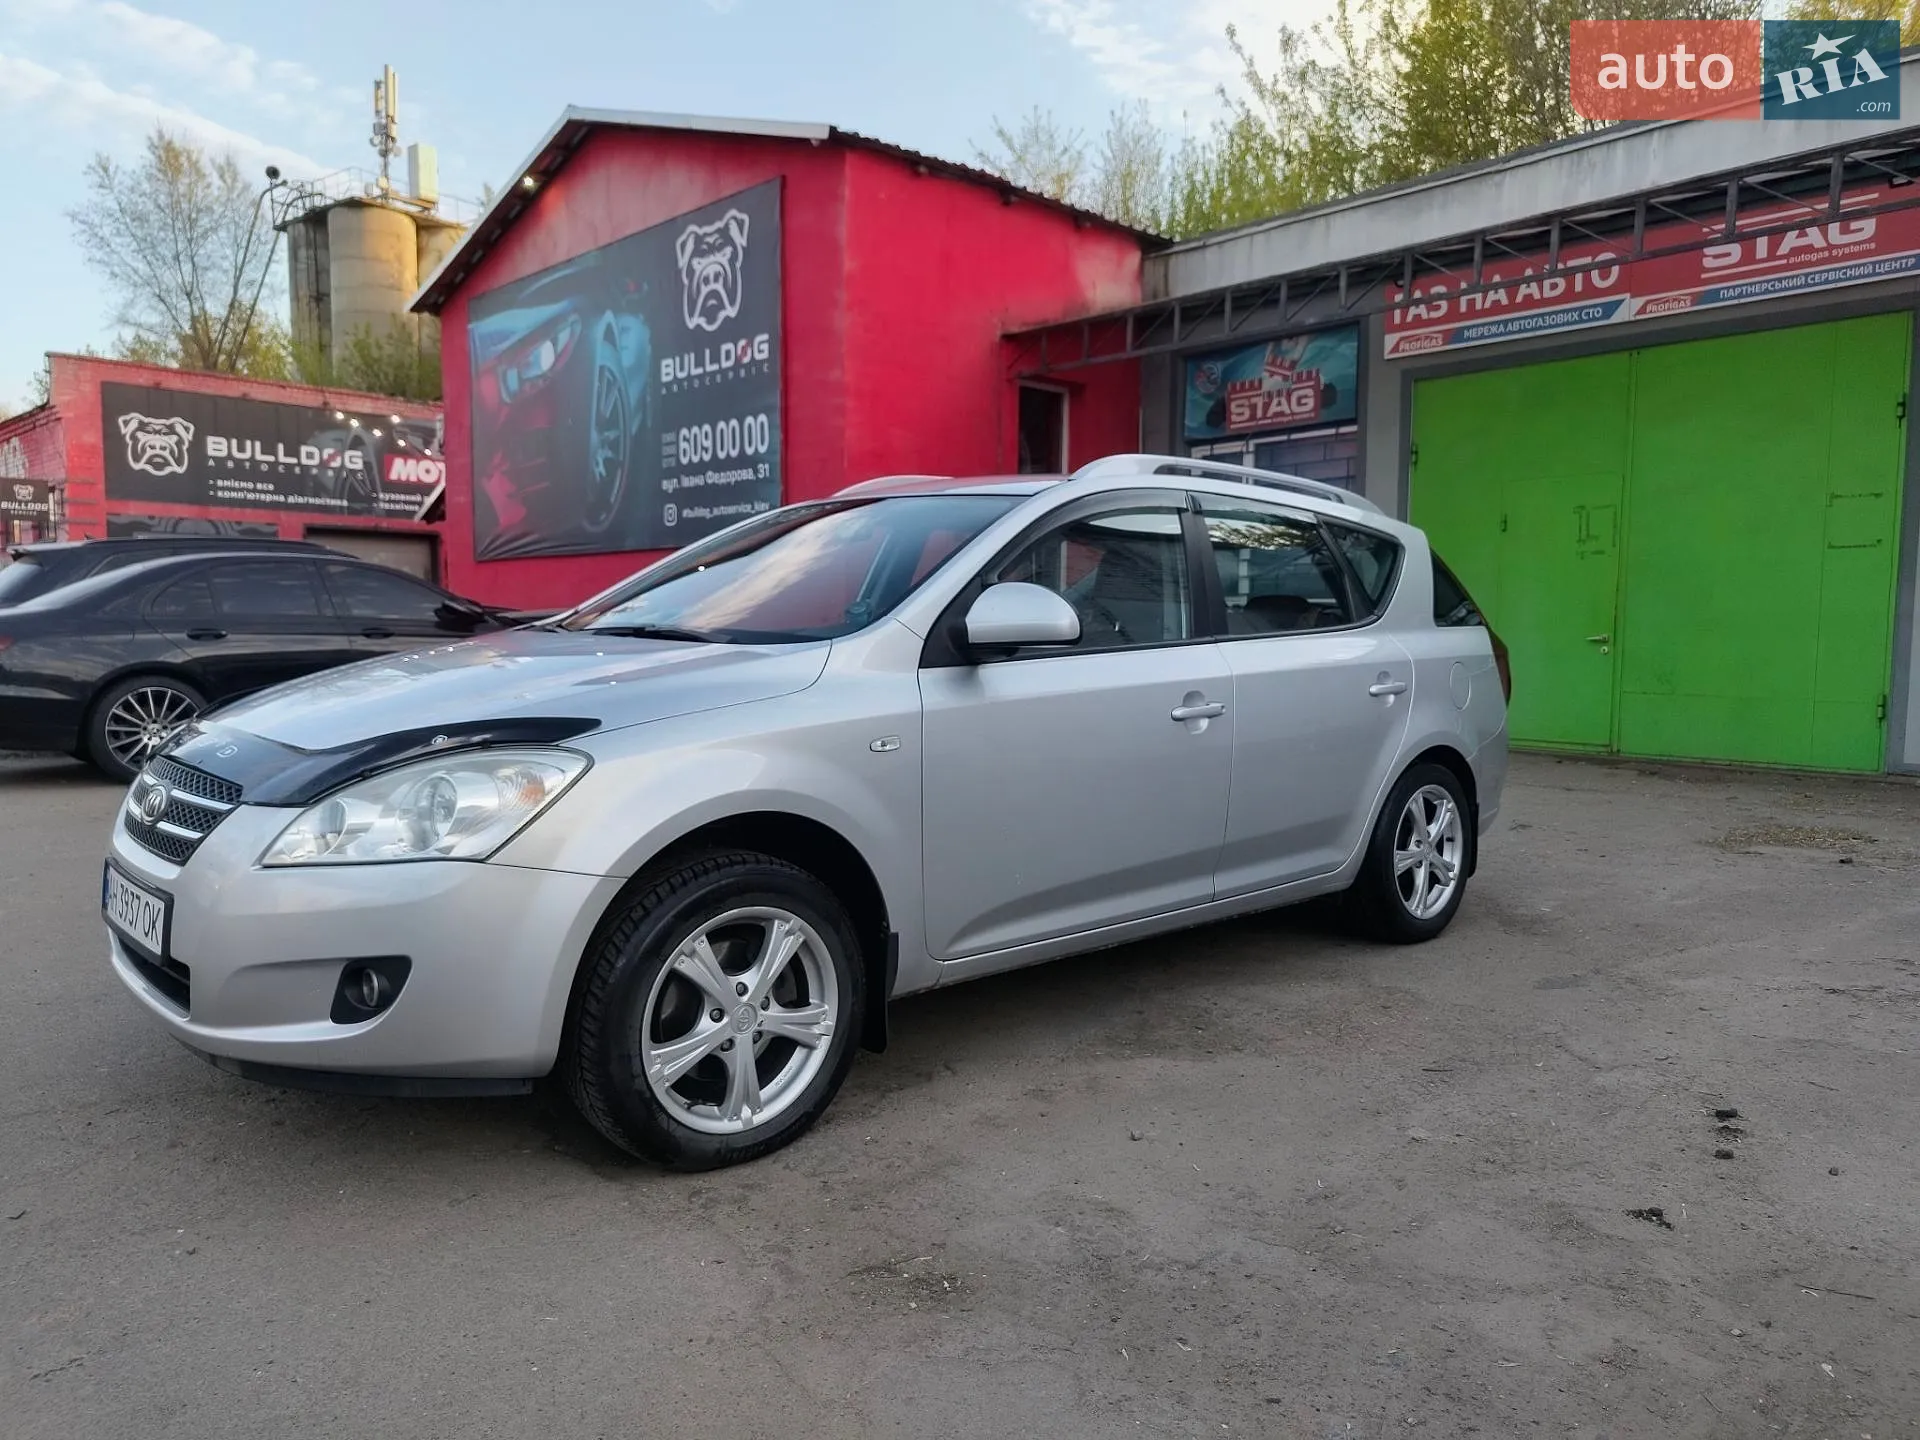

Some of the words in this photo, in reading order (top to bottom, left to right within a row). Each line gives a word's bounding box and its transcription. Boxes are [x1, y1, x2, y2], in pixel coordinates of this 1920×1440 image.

[1702, 205, 1878, 268] STAG
[1788, 250, 1829, 264] autogas
[1831, 241, 1876, 257] systems
[1515, 252, 1620, 305] АВТО
[1719, 275, 1806, 299] ПАРТНЕРСЬКИЙ
[1807, 262, 1873, 285] СЕРВІСНИЙ
[1875, 257, 1916, 275] ЦЕНТР
[1463, 322, 1506, 339] МЕРЕЖА
[1506, 311, 1579, 333] АВТОГАЗОВИХ
[1581, 307, 1603, 320] СТО
[661, 333, 770, 384] BULLDOG
[1230, 388, 1316, 423] STAG
[206, 435, 364, 470] BULLDOG
[679, 423, 713, 466] 609
[716, 418, 741, 460] 00
[743, 412, 770, 456] 00
[757, 463, 770, 479] 31
[1, 500, 49, 512] BULLDOG
[118, 883, 142, 931] 3937
[142, 900, 162, 946] OK
